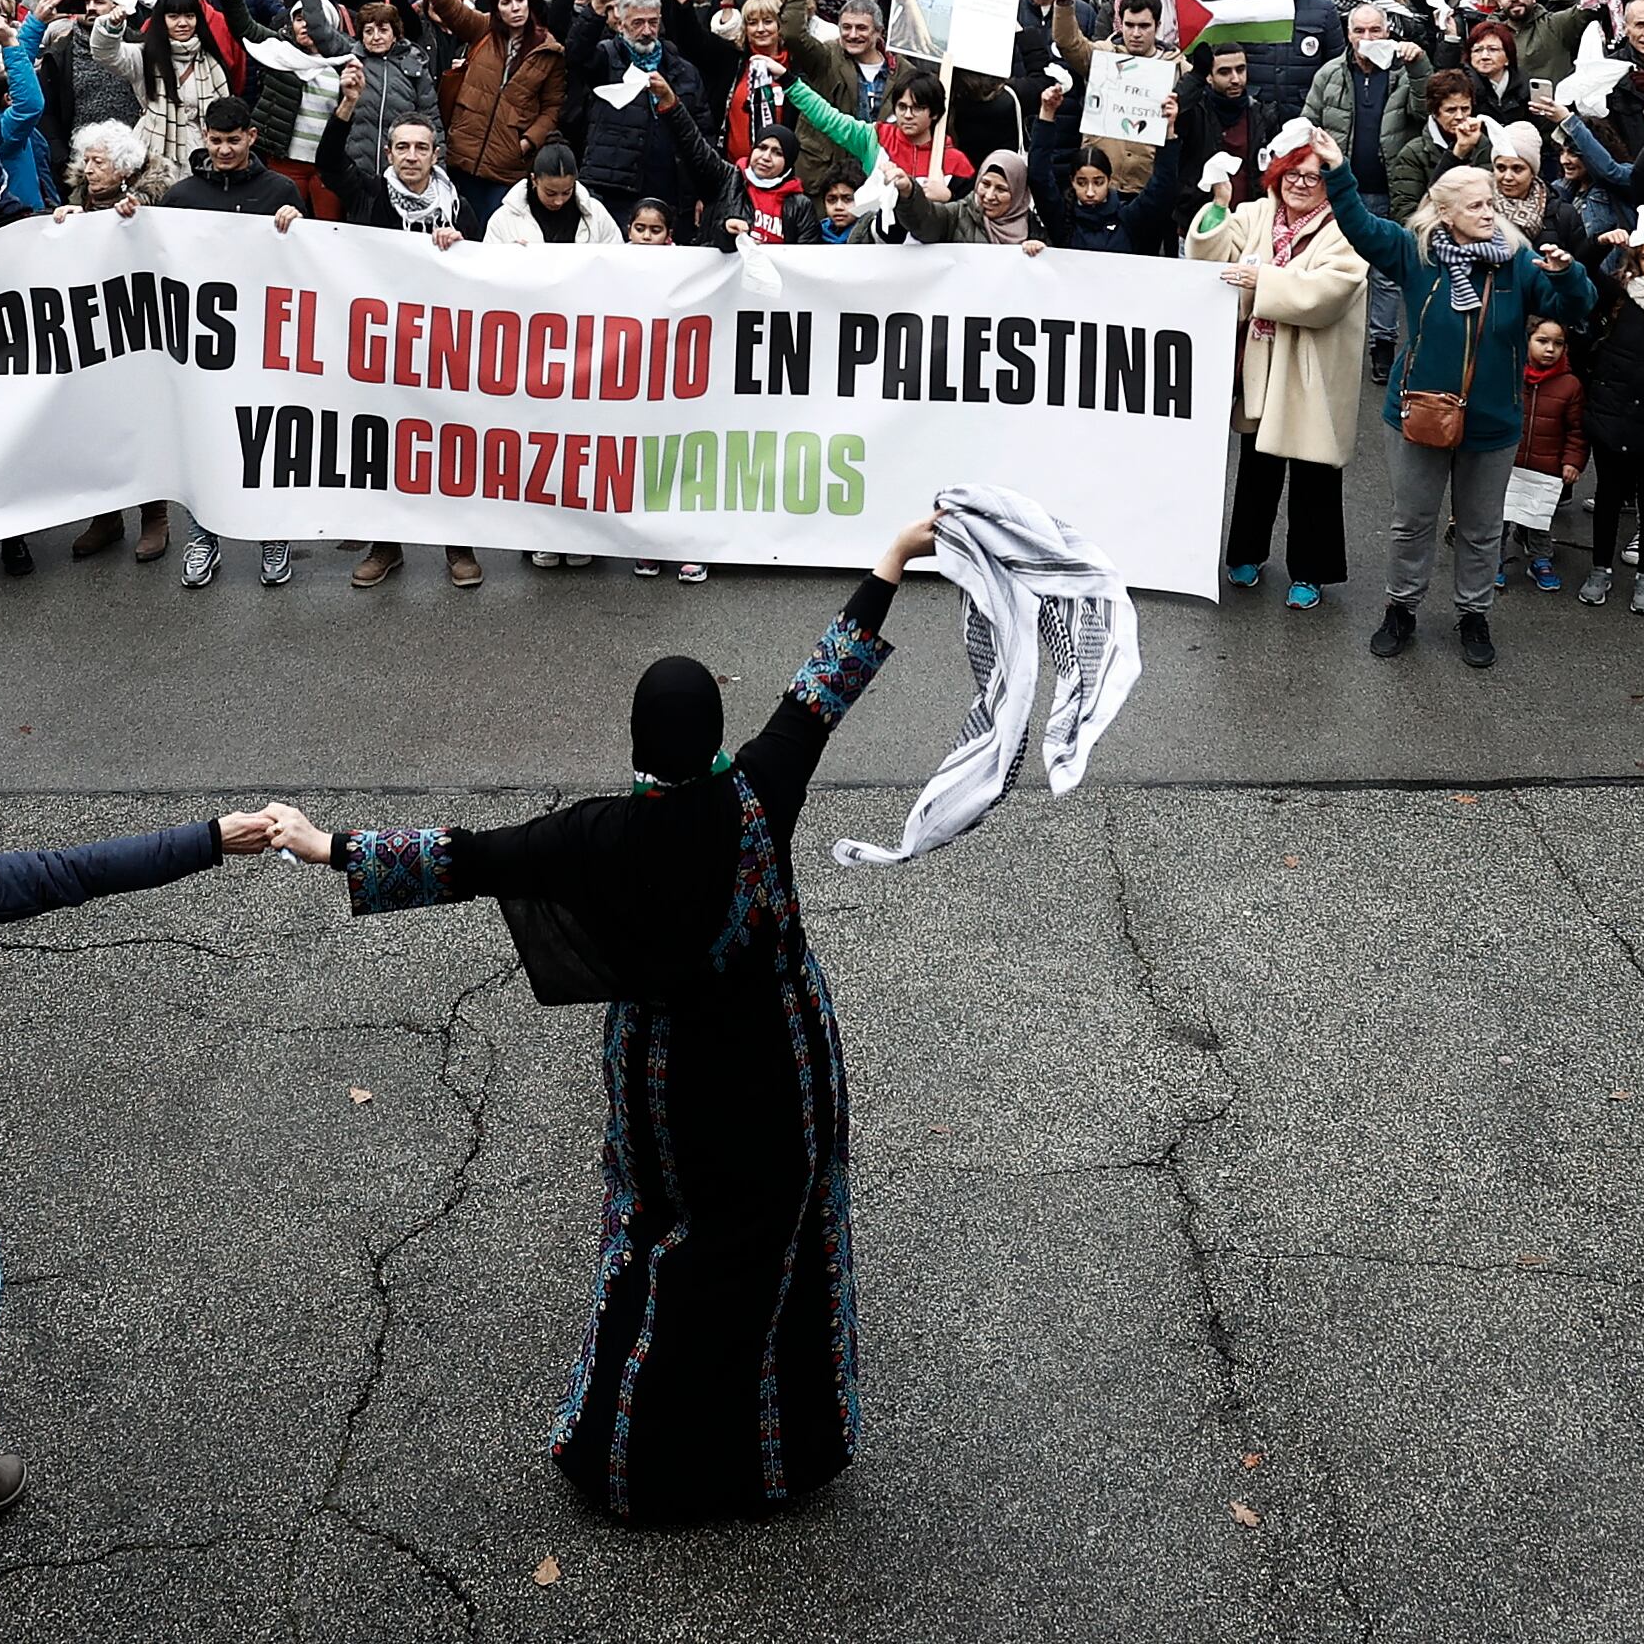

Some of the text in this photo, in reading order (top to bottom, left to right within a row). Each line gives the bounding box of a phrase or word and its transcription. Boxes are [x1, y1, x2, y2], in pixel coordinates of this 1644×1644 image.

[1112, 104, 1162, 118] PALESTIN
[263, 287, 324, 375] EL
[348, 298, 713, 401] GENOCIDIO
[735, 311, 812, 396] EN
[838, 313, 1193, 420] PALESTINA
